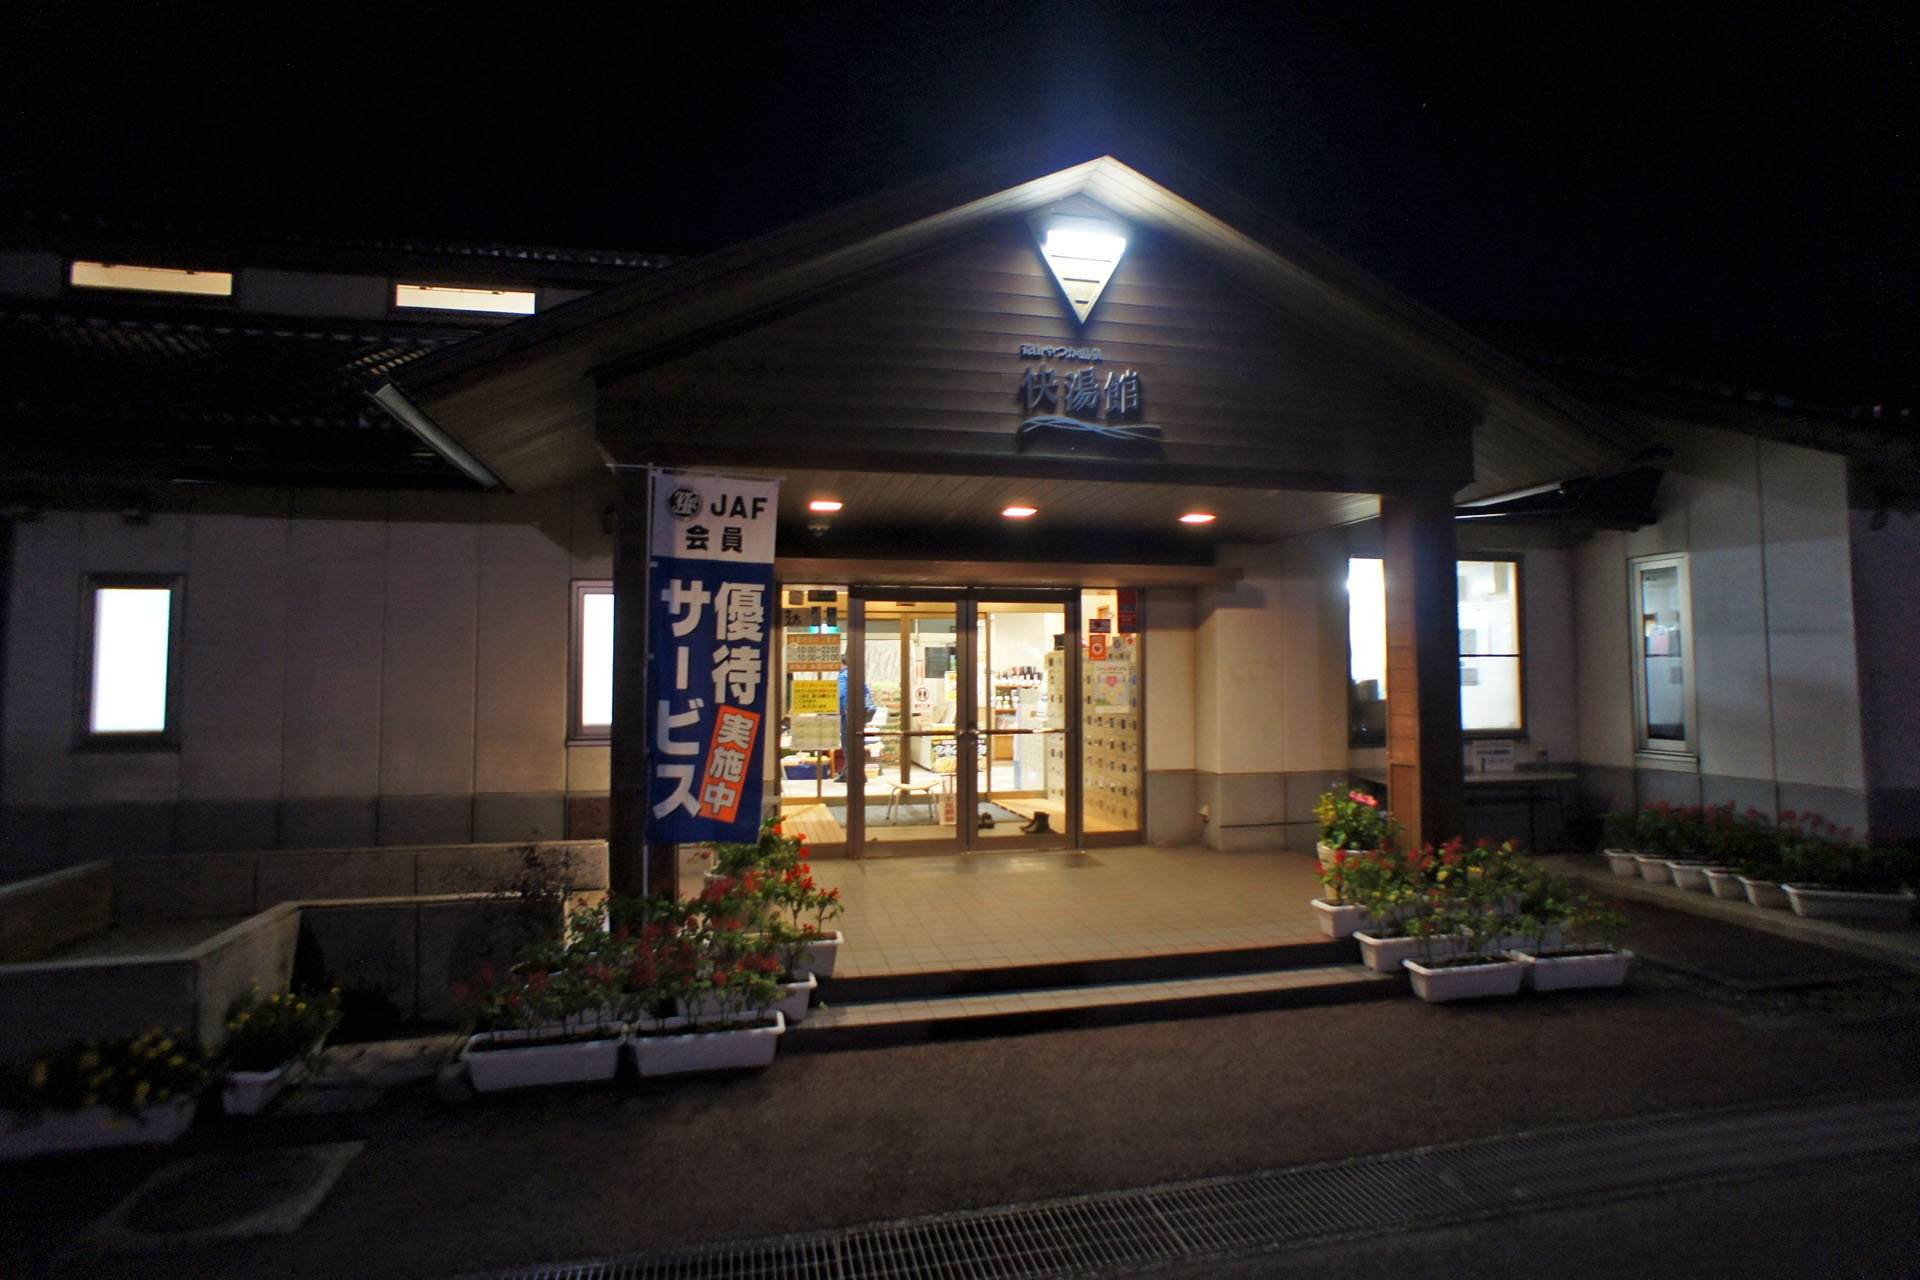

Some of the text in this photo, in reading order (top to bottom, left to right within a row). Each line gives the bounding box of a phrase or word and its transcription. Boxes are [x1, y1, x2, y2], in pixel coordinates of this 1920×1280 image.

[686, 525, 743, 553] 会員
[711, 494, 768, 519] JAF
[712, 582, 766, 705] 優待
[654, 579, 710, 817] サービス
[705, 714, 753, 815] 実施中
